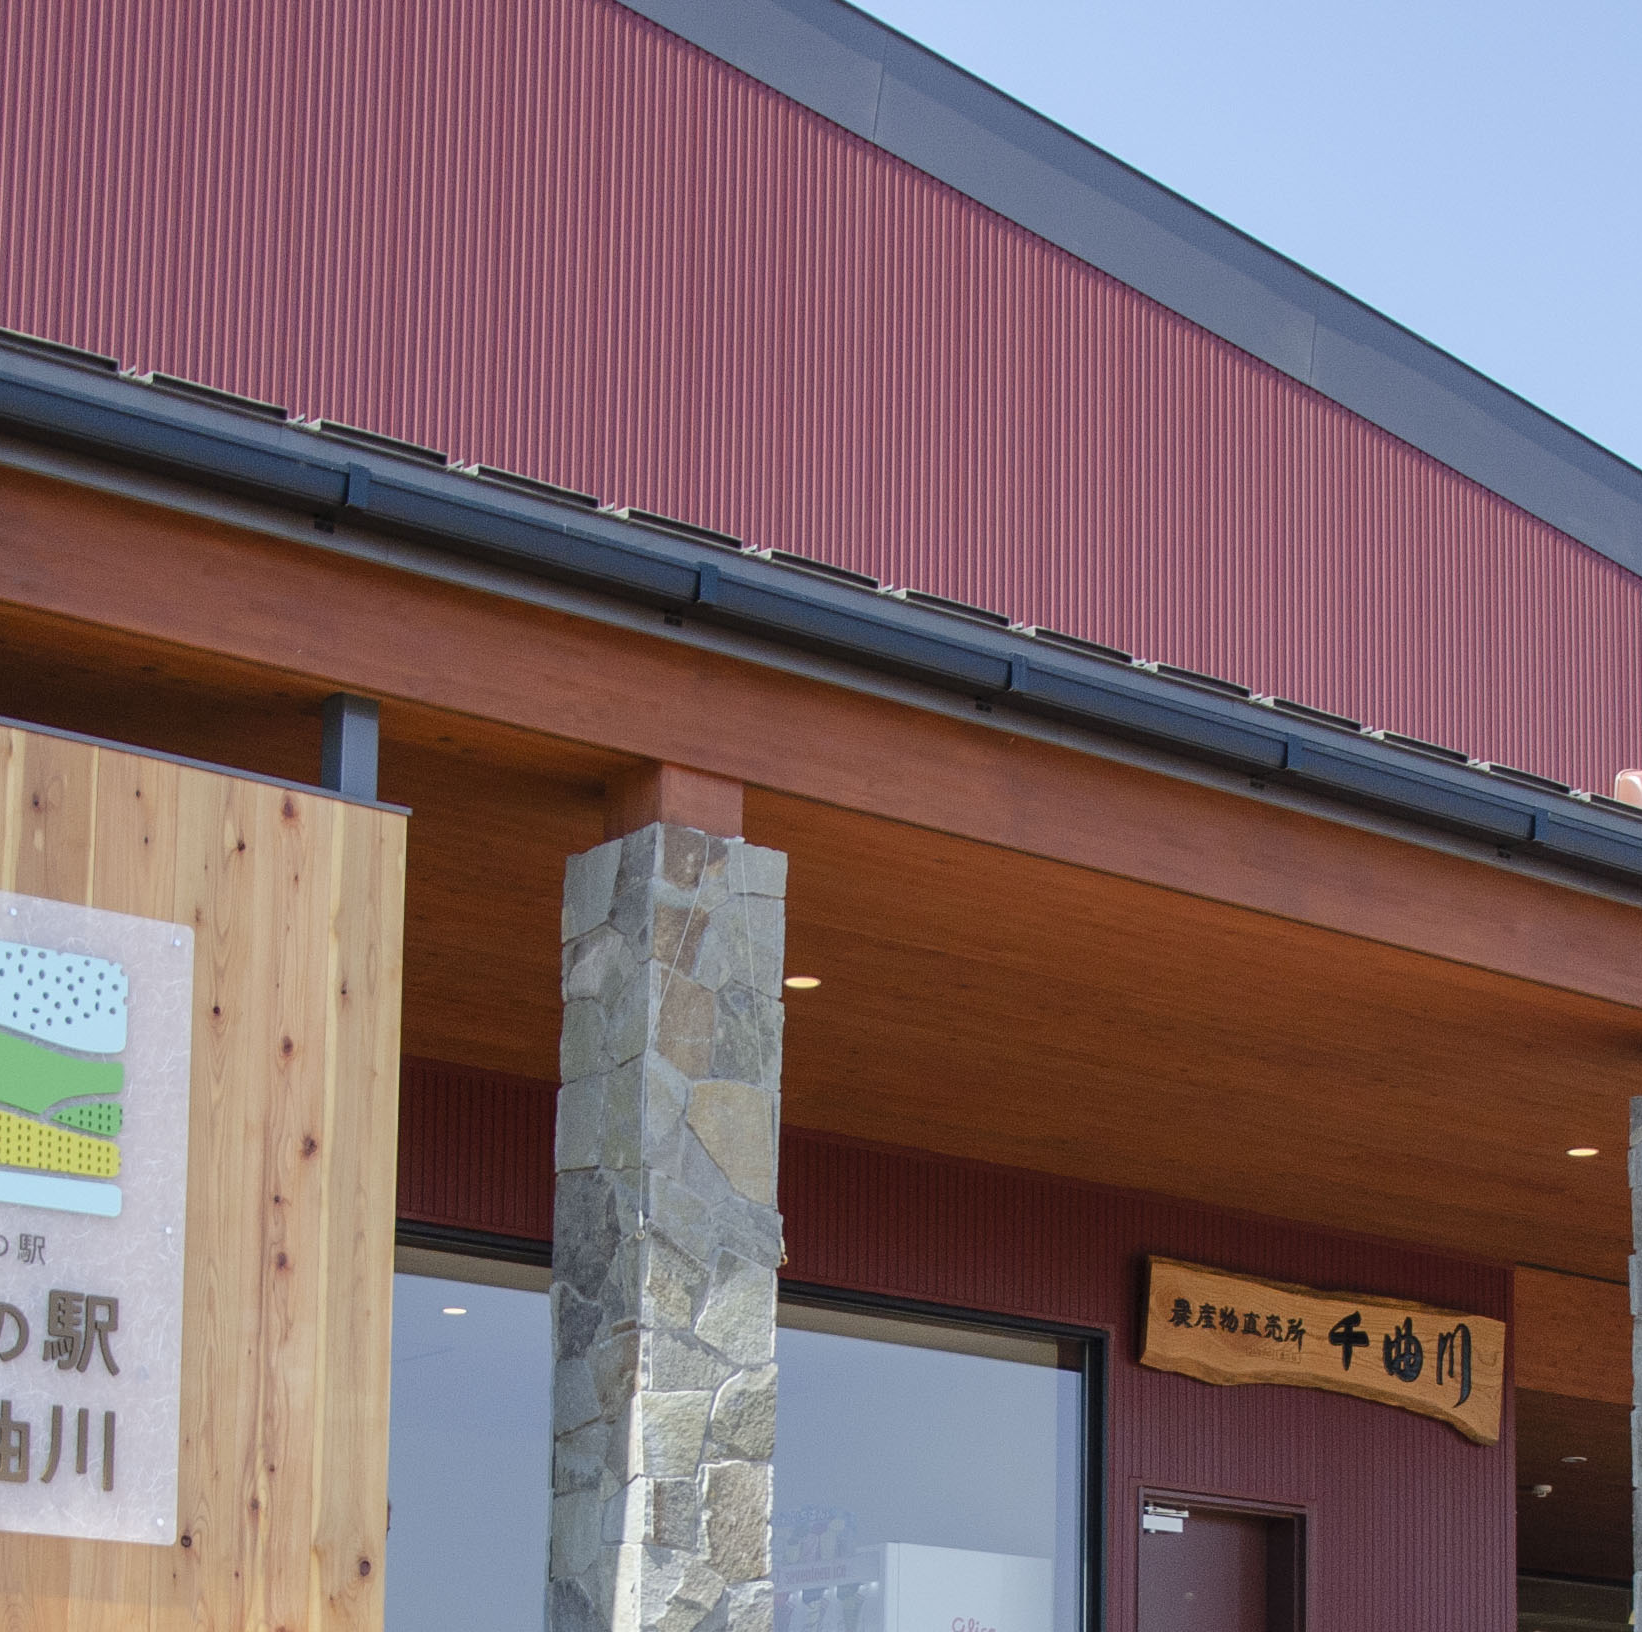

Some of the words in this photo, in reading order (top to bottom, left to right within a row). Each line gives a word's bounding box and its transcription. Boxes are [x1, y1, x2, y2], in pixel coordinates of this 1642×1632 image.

[1169, 1297, 1306, 1352] 農産物直売所
[1329, 1310, 1472, 1408] 千曲川
